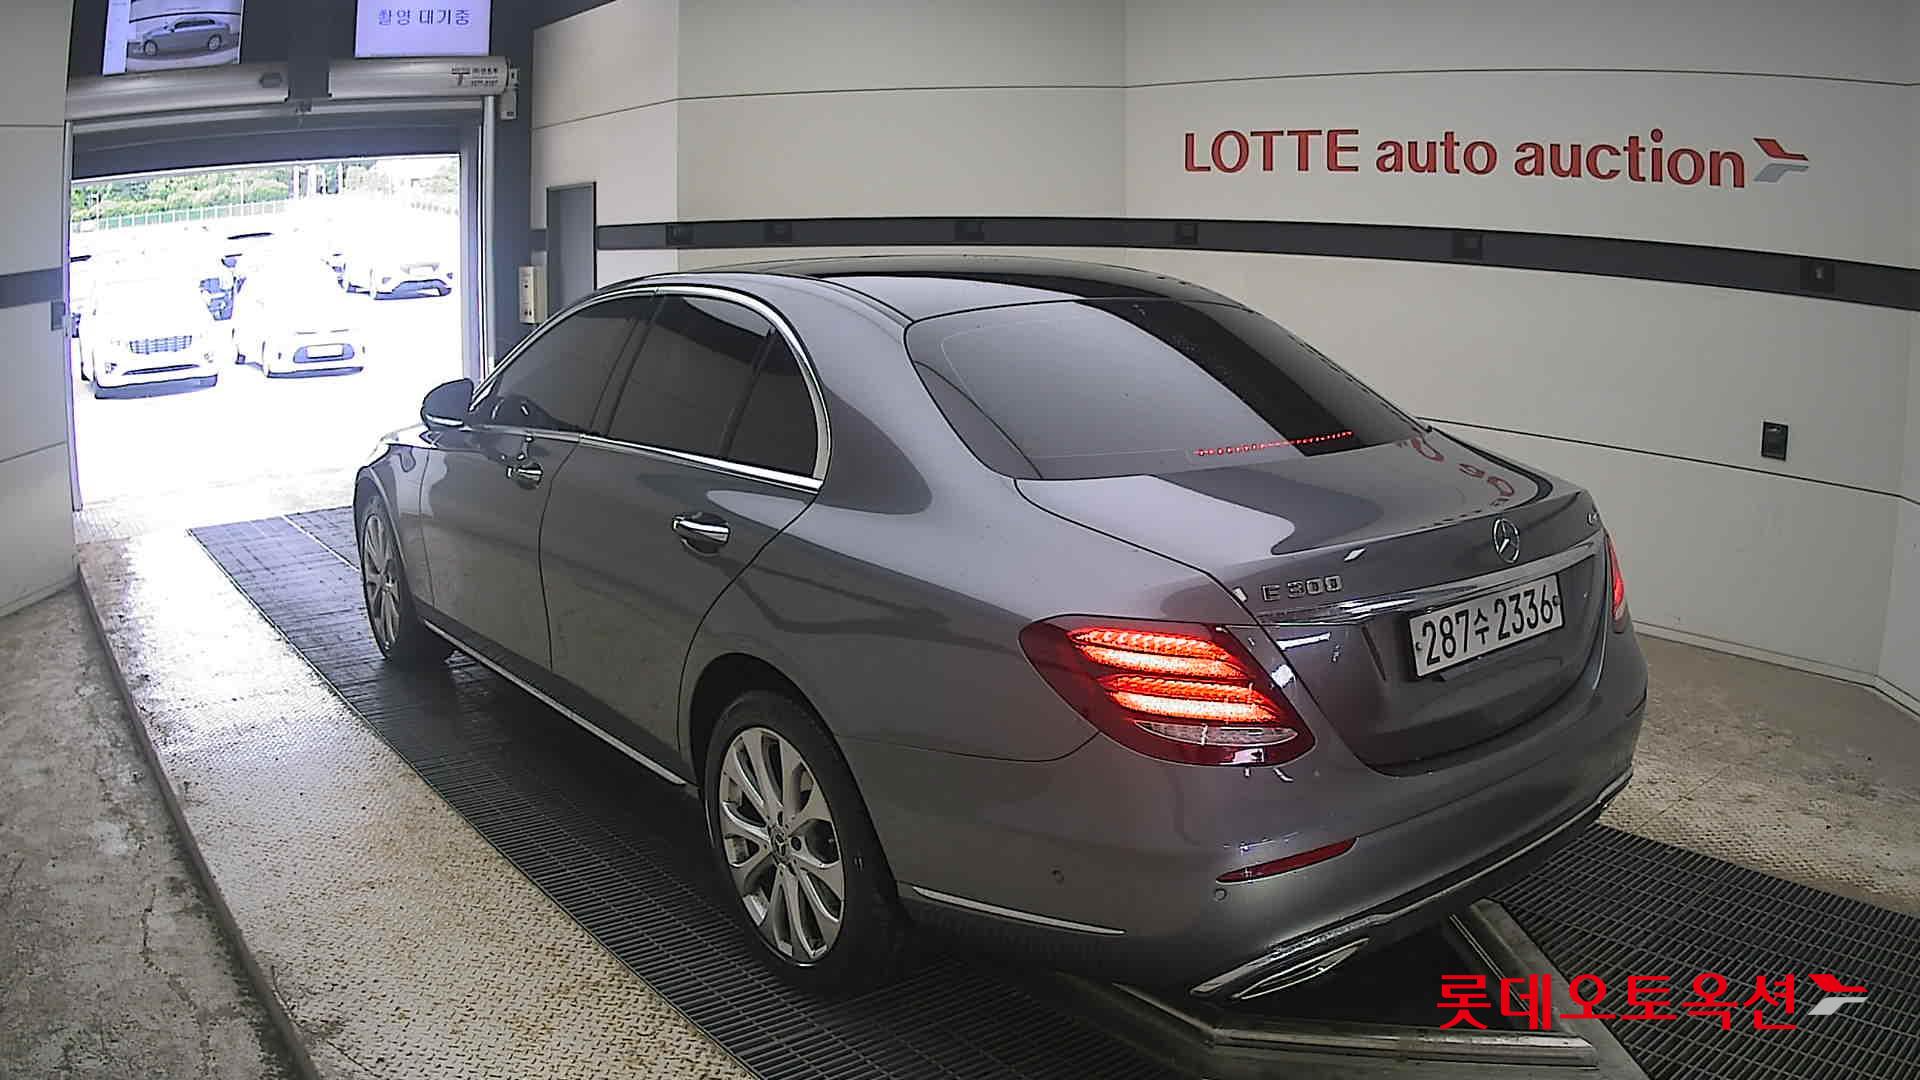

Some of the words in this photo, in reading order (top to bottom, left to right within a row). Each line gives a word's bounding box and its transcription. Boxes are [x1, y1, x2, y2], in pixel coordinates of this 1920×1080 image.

[419, 8, 470, 26] 대기중
[1185, 129, 1360, 172] LOTTE
[1376, 131, 1498, 175] auto
[1514, 129, 1746, 188] auction
[1261, 584, 1282, 602] E
[1287, 575, 1342, 599] 300
